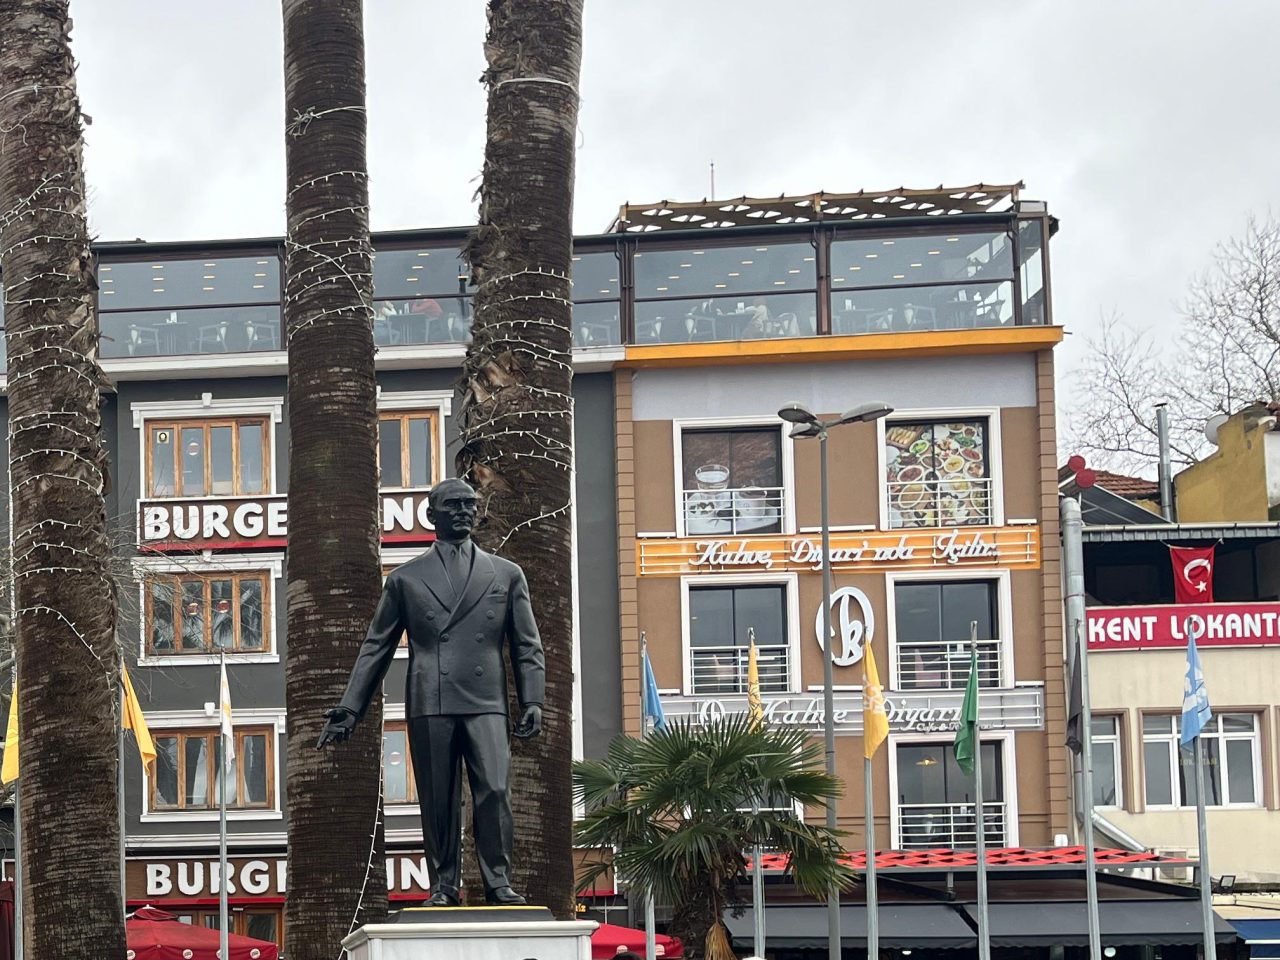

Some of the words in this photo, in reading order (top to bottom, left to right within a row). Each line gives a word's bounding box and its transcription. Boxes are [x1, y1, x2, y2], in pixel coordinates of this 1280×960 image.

[143, 503, 288, 540] BURGE
[1088, 616, 1158, 643] KENT
[1170, 612, 1280, 640] LOKANT
[146, 860, 288, 896] BURG
